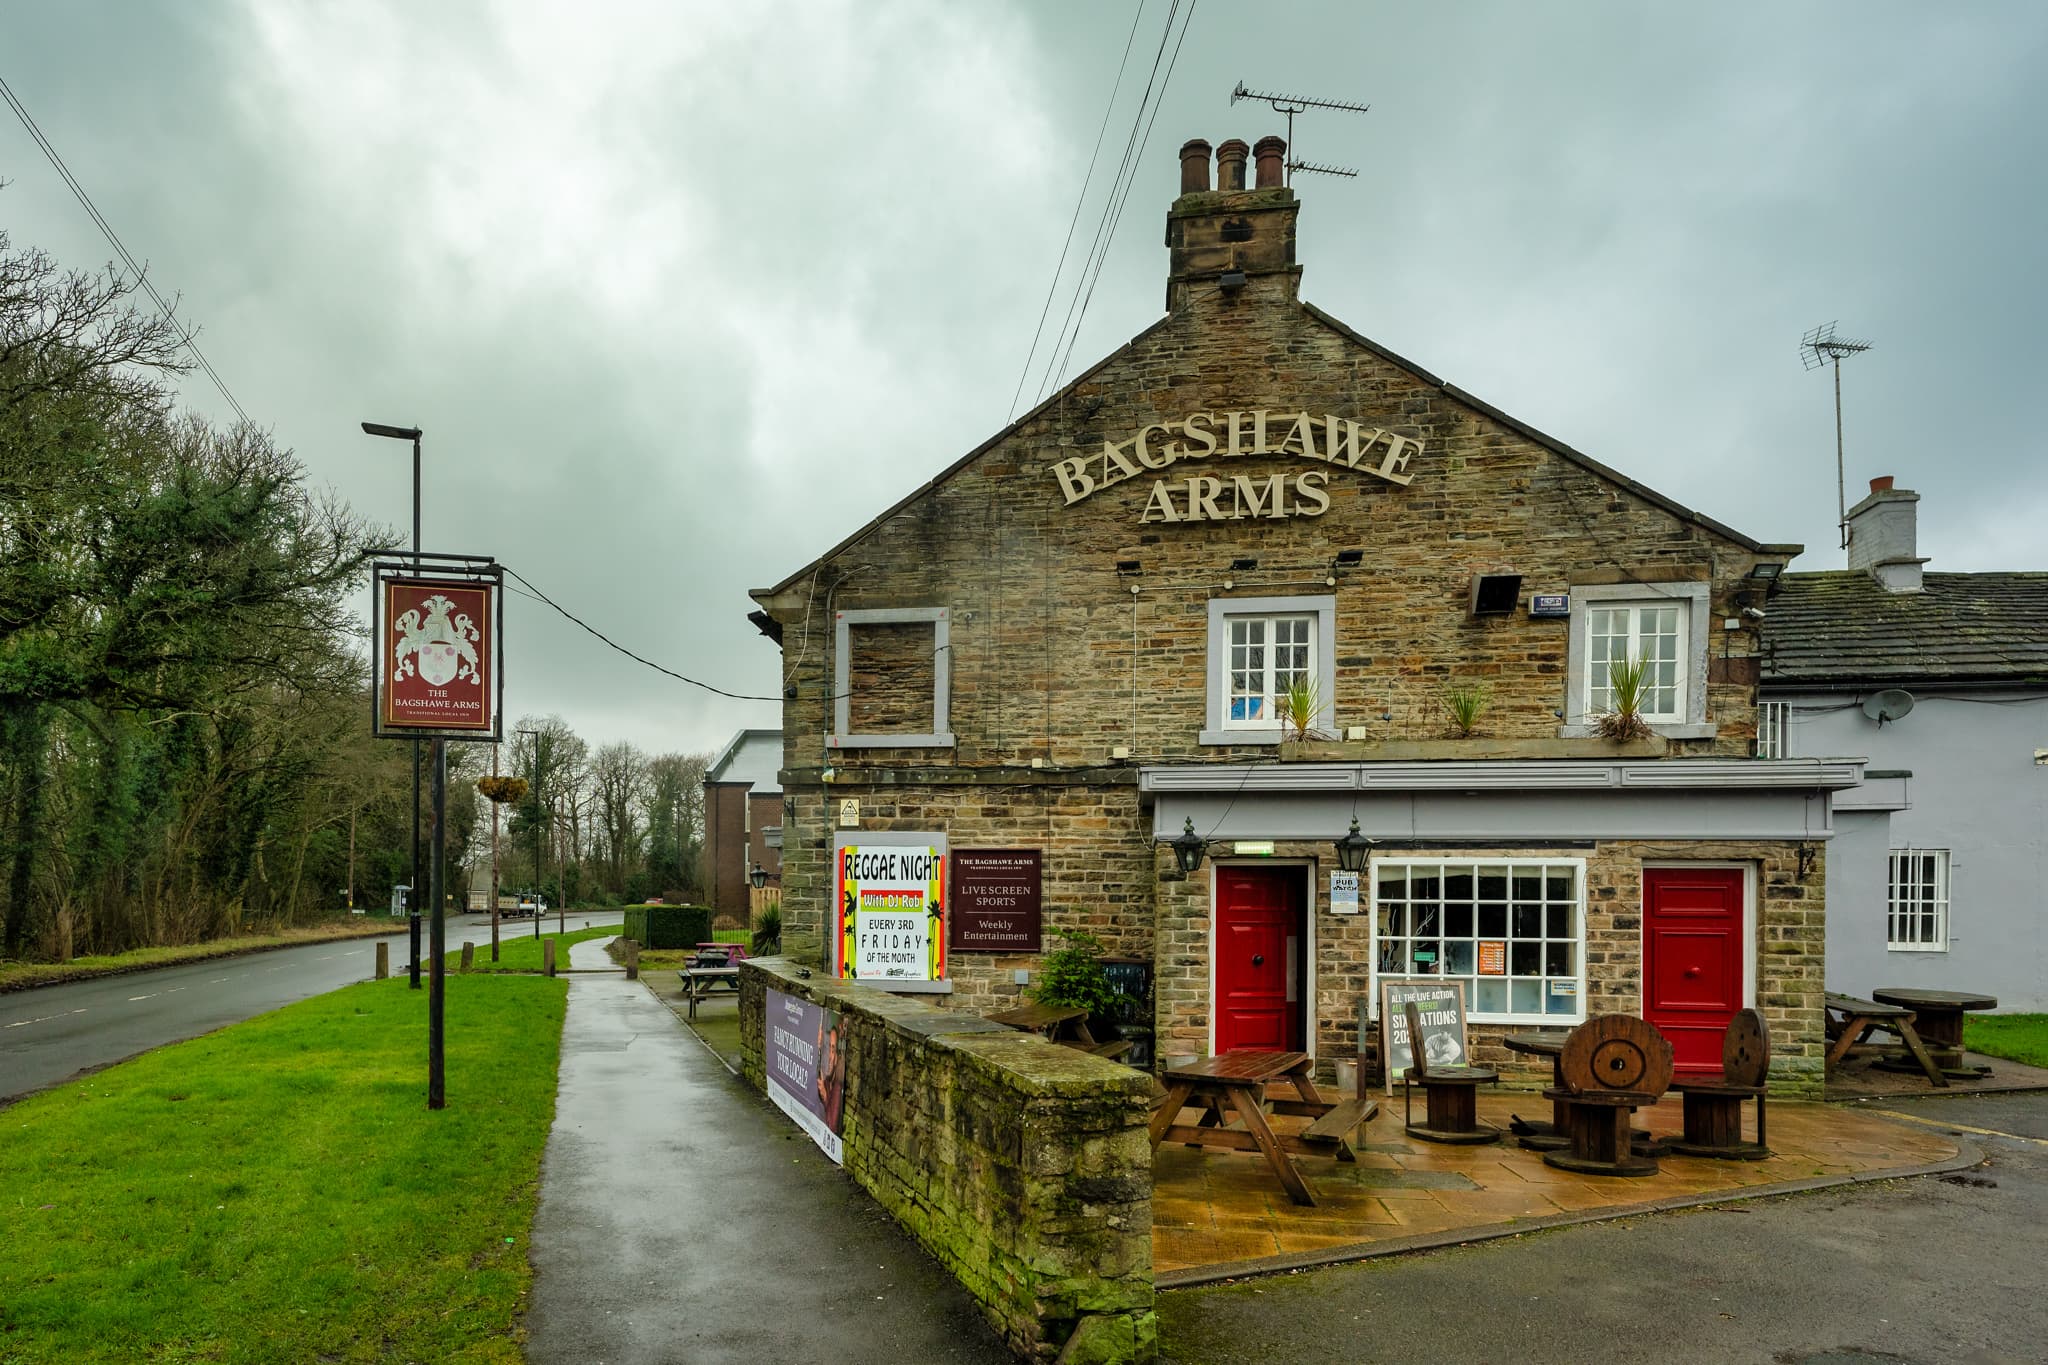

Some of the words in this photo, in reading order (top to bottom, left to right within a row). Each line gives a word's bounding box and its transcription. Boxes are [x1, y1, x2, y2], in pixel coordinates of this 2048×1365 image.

[1048, 409, 1425, 507] BAGSHAWE
[1138, 471, 1331, 524] ARMS
[428, 689, 448, 698] THE
[395, 698, 451, 708] BAGSHAWE
[452, 701, 480, 709] ARMS
[845, 853, 897, 881] REGGAE
[900, 855, 941, 881] NIGHT
[962, 885, 987, 895] LIVE
[988, 886, 1031, 895] SCREEN
[863, 894, 885, 908] With
[888, 894, 899, 908] DJ
[902, 894, 920, 908] Rob
[976, 897, 1016, 906] SPORTS
[869, 919, 896, 930] EVERY
[898, 919, 914, 930] 3RD
[978, 920, 1013, 931] Weekly
[861, 934, 922, 949] FRIDAY
[963, 931, 1028, 940] Entertainment
[866, 952, 876, 963] OF
[877, 952, 890, 963] THE
[891, 952, 916, 963] MONTH
[1391, 994, 1403, 1004] ALL
[1404, 993, 1416, 1003] THE
[1416, 991, 1430, 1001] LIVE
[1431, 990, 1456, 1000] ACTION,
[1391, 1003, 1403, 1013] ALL
[1420, 1010, 1457, 1027] ATIONS
[774, 1025, 789, 1050] FANCY
[789, 1033, 813, 1065] RUNNING
[776, 1050, 790, 1077] YOUR
[789, 1060, 808, 1090] LOCAL?
